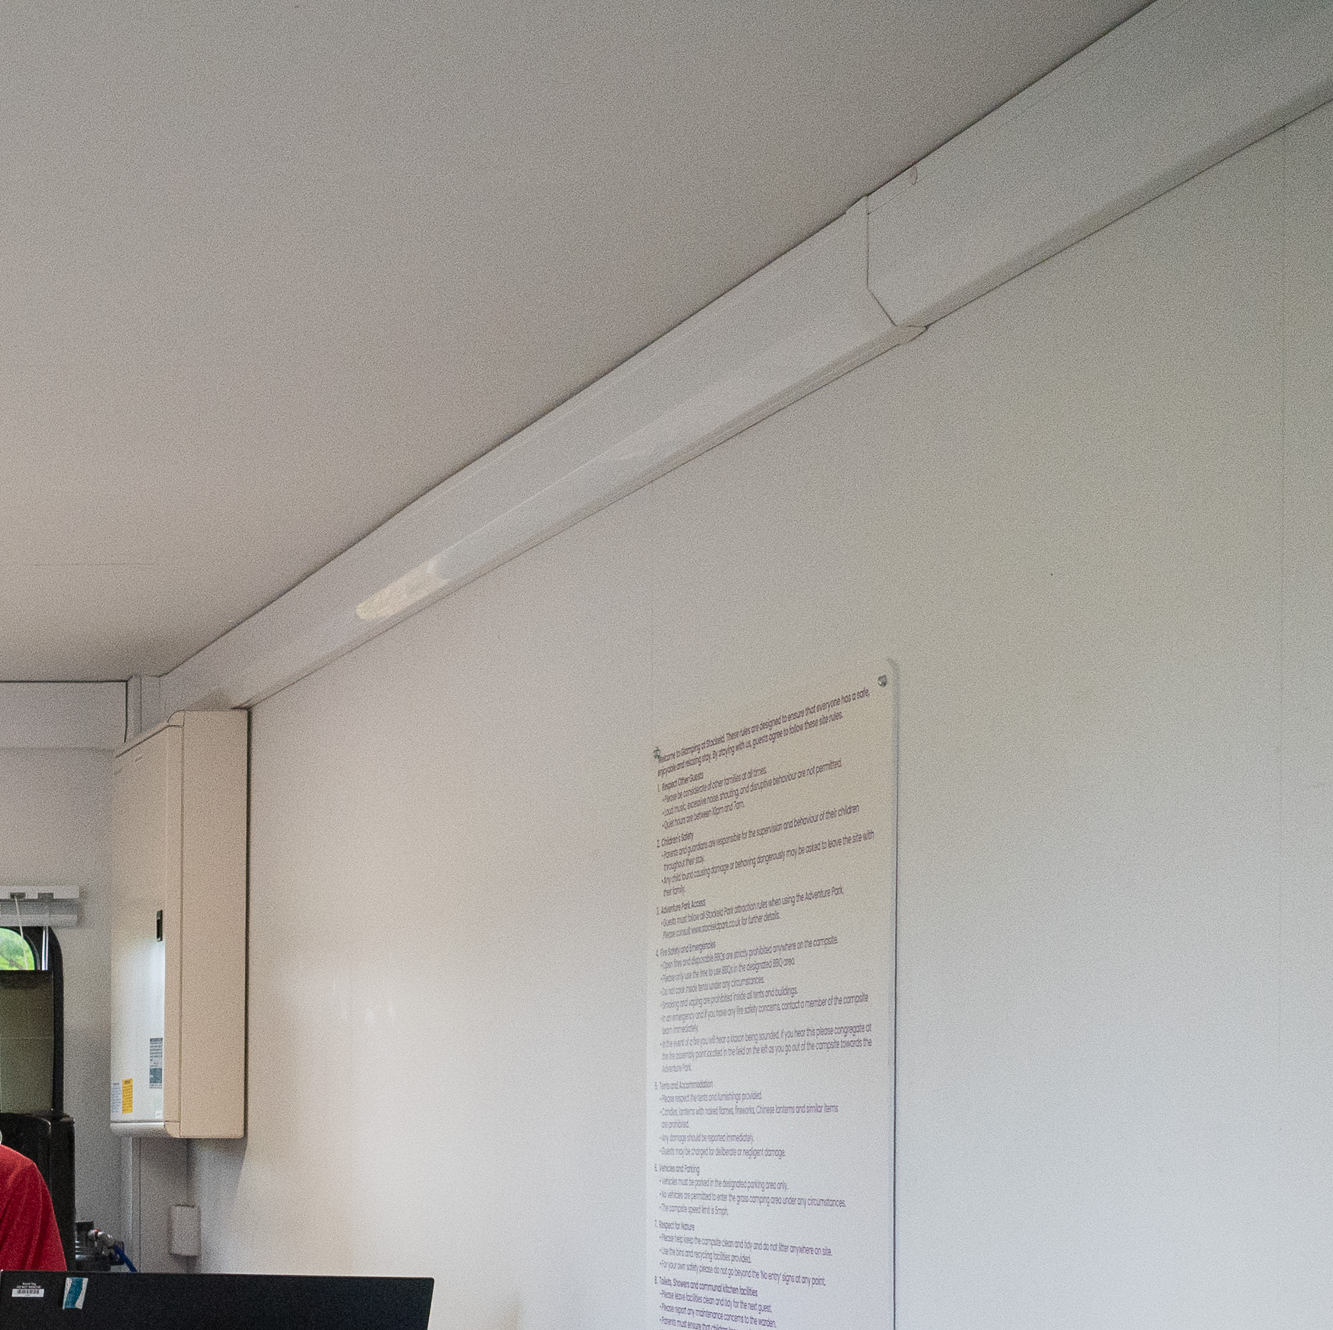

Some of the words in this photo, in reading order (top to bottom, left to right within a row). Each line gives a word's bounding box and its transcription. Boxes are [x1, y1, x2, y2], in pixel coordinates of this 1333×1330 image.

[782, 713, 787, 725] to
[787, 709, 804, 723] ensure
[805, 704, 815, 717] that
[816, 697, 840, 716] everyone
[841, 692, 851, 706] has
[856, 685, 870, 702] safe,
